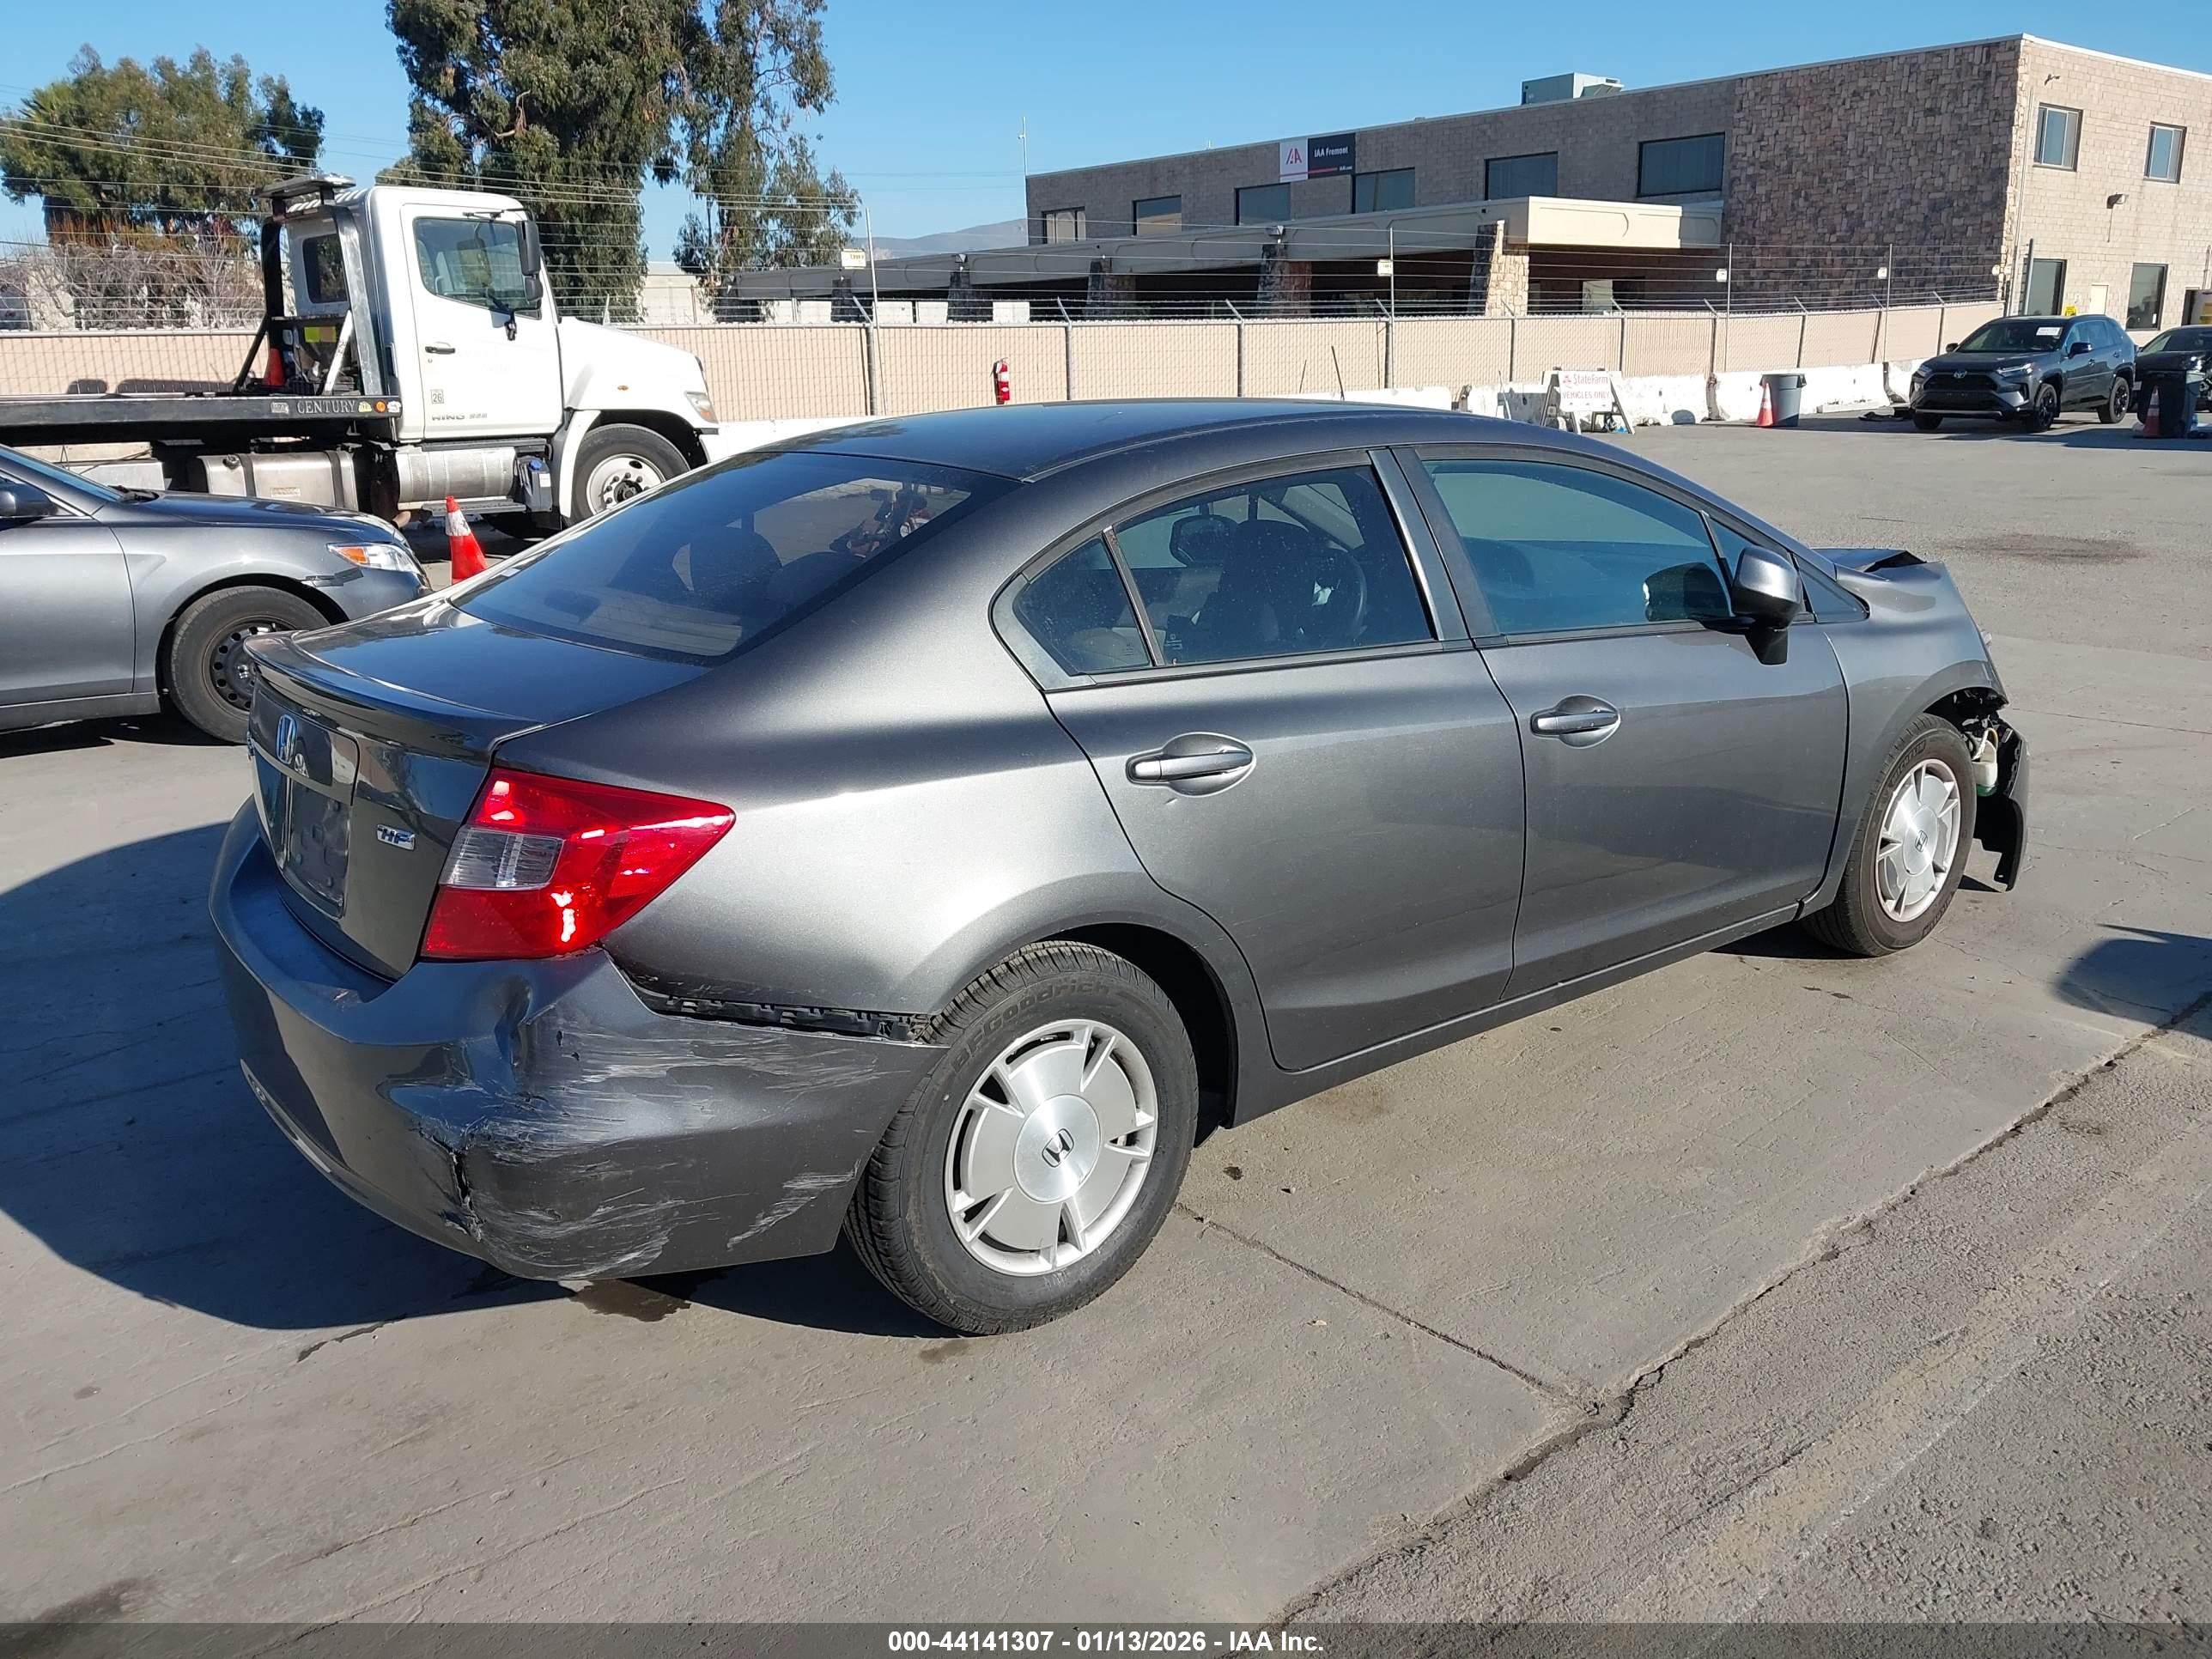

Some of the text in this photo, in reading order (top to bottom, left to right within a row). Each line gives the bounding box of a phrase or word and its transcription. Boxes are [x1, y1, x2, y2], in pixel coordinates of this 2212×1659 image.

[1314, 146, 1349, 158] IAA Fremont
[432, 392, 443, 403] 26
[1562, 391, 1610, 399] VEHICLES ONLY
[297, 399, 356, 414] CENTURY
[378, 825, 415, 847] HF
